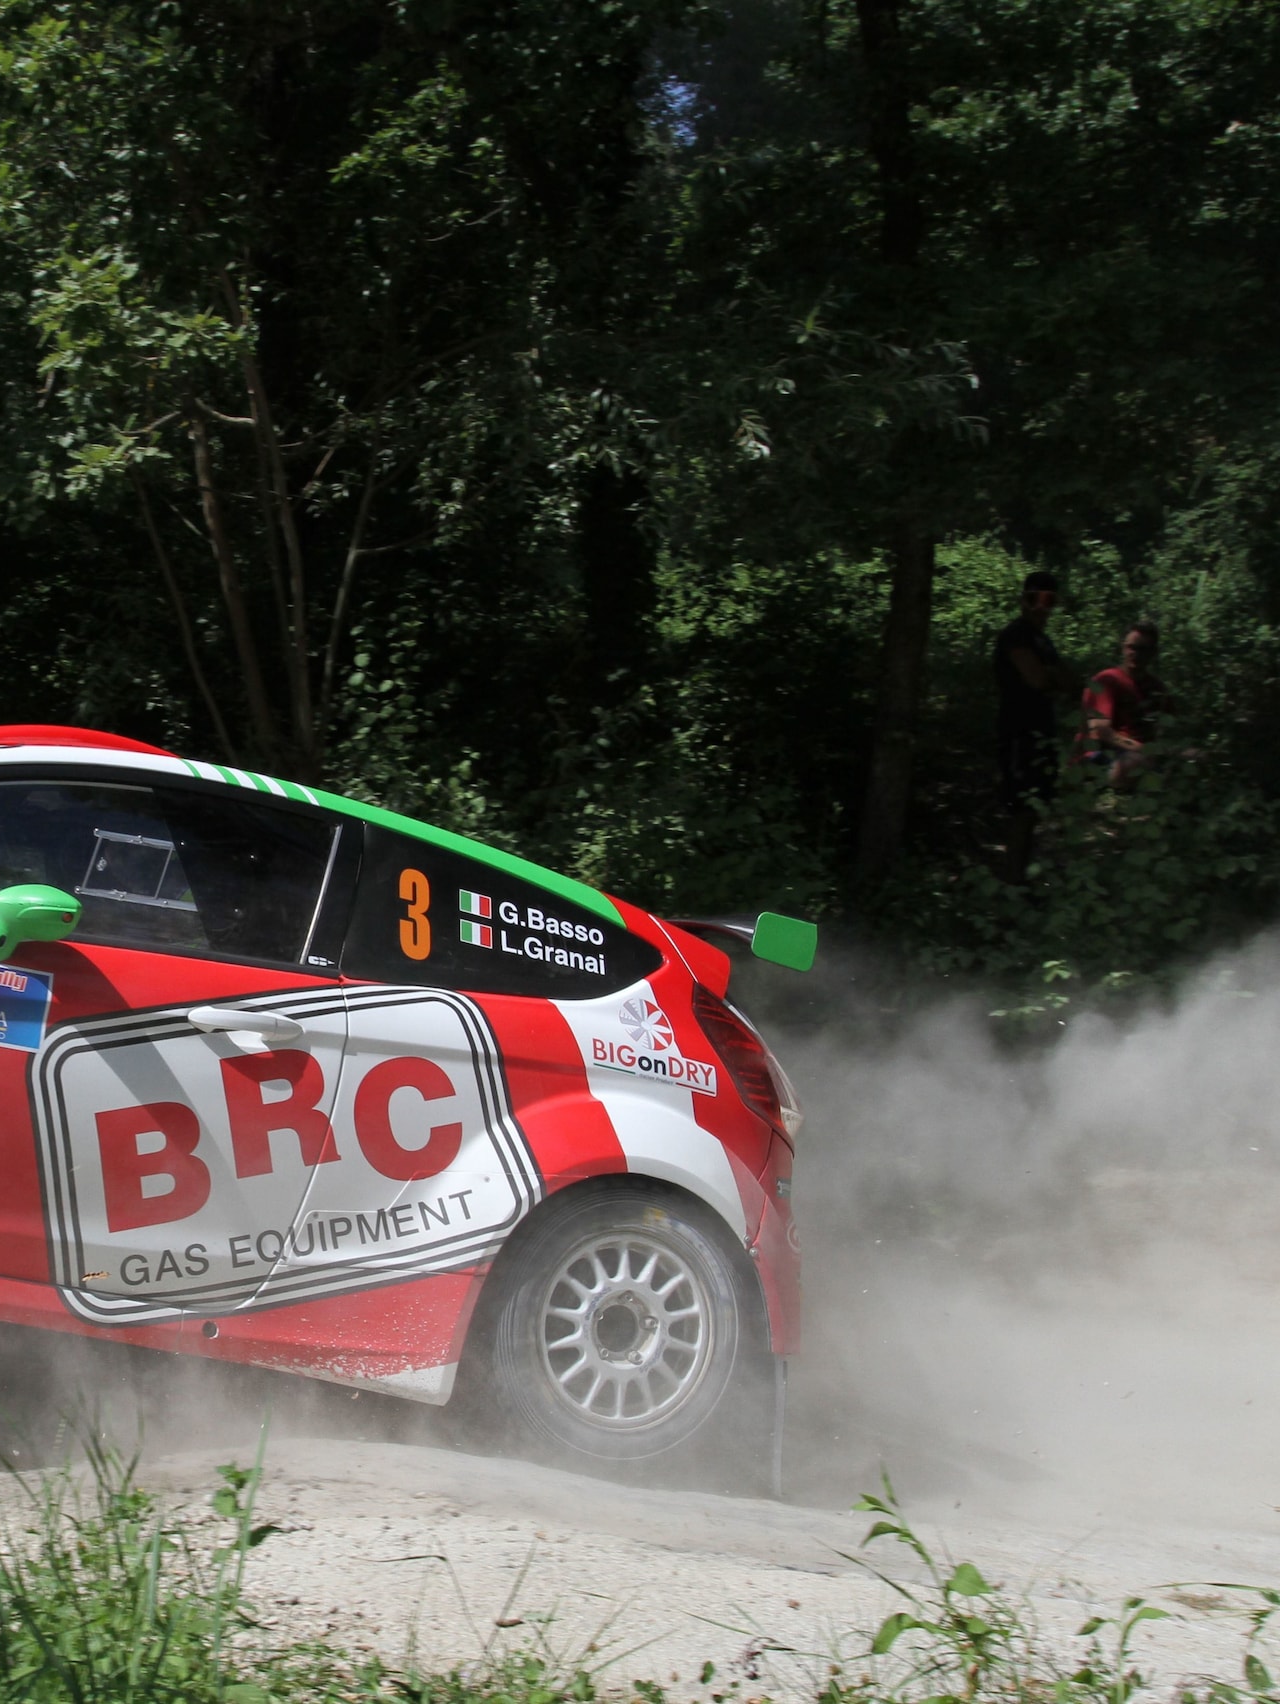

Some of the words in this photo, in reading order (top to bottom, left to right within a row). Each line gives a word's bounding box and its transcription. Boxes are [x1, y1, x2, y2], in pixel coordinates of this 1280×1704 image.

[398, 868, 431, 960] 3
[498, 901, 604, 946] G.Basso
[500, 929, 606, 975] L.Granai
[592, 1038, 713, 1087] BIGonDRY
[95, 1048, 463, 1233] BRC
[120, 1243, 210, 1285] GAS
[229, 1189, 473, 1268] EQUIPMENT
